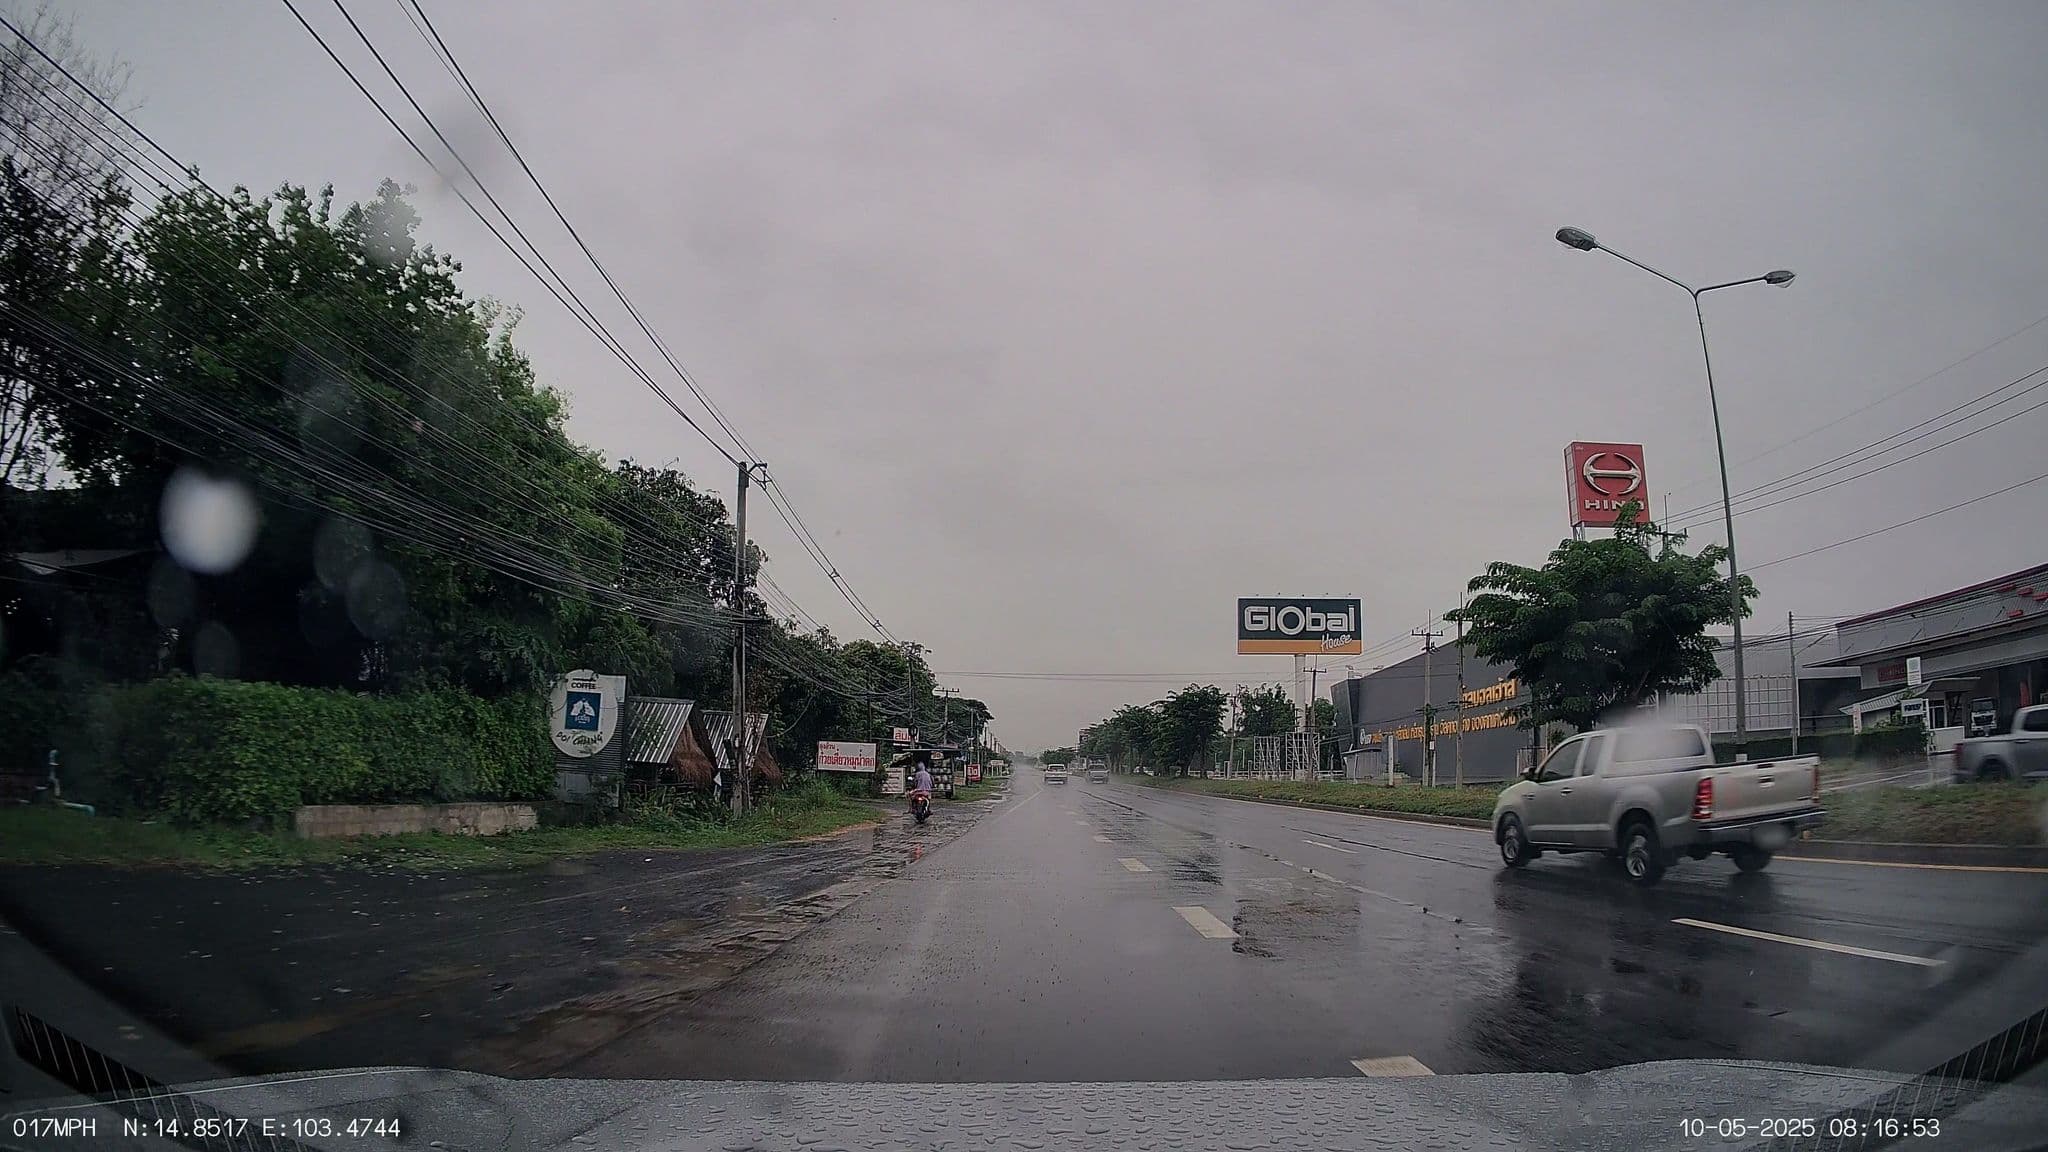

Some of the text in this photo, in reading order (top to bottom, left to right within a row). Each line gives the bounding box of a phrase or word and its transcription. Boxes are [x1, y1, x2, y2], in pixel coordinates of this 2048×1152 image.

[1584, 499, 1645, 511] HIN
[1320, 632, 1353, 653] House
[571, 682, 597, 690] COFFEE
